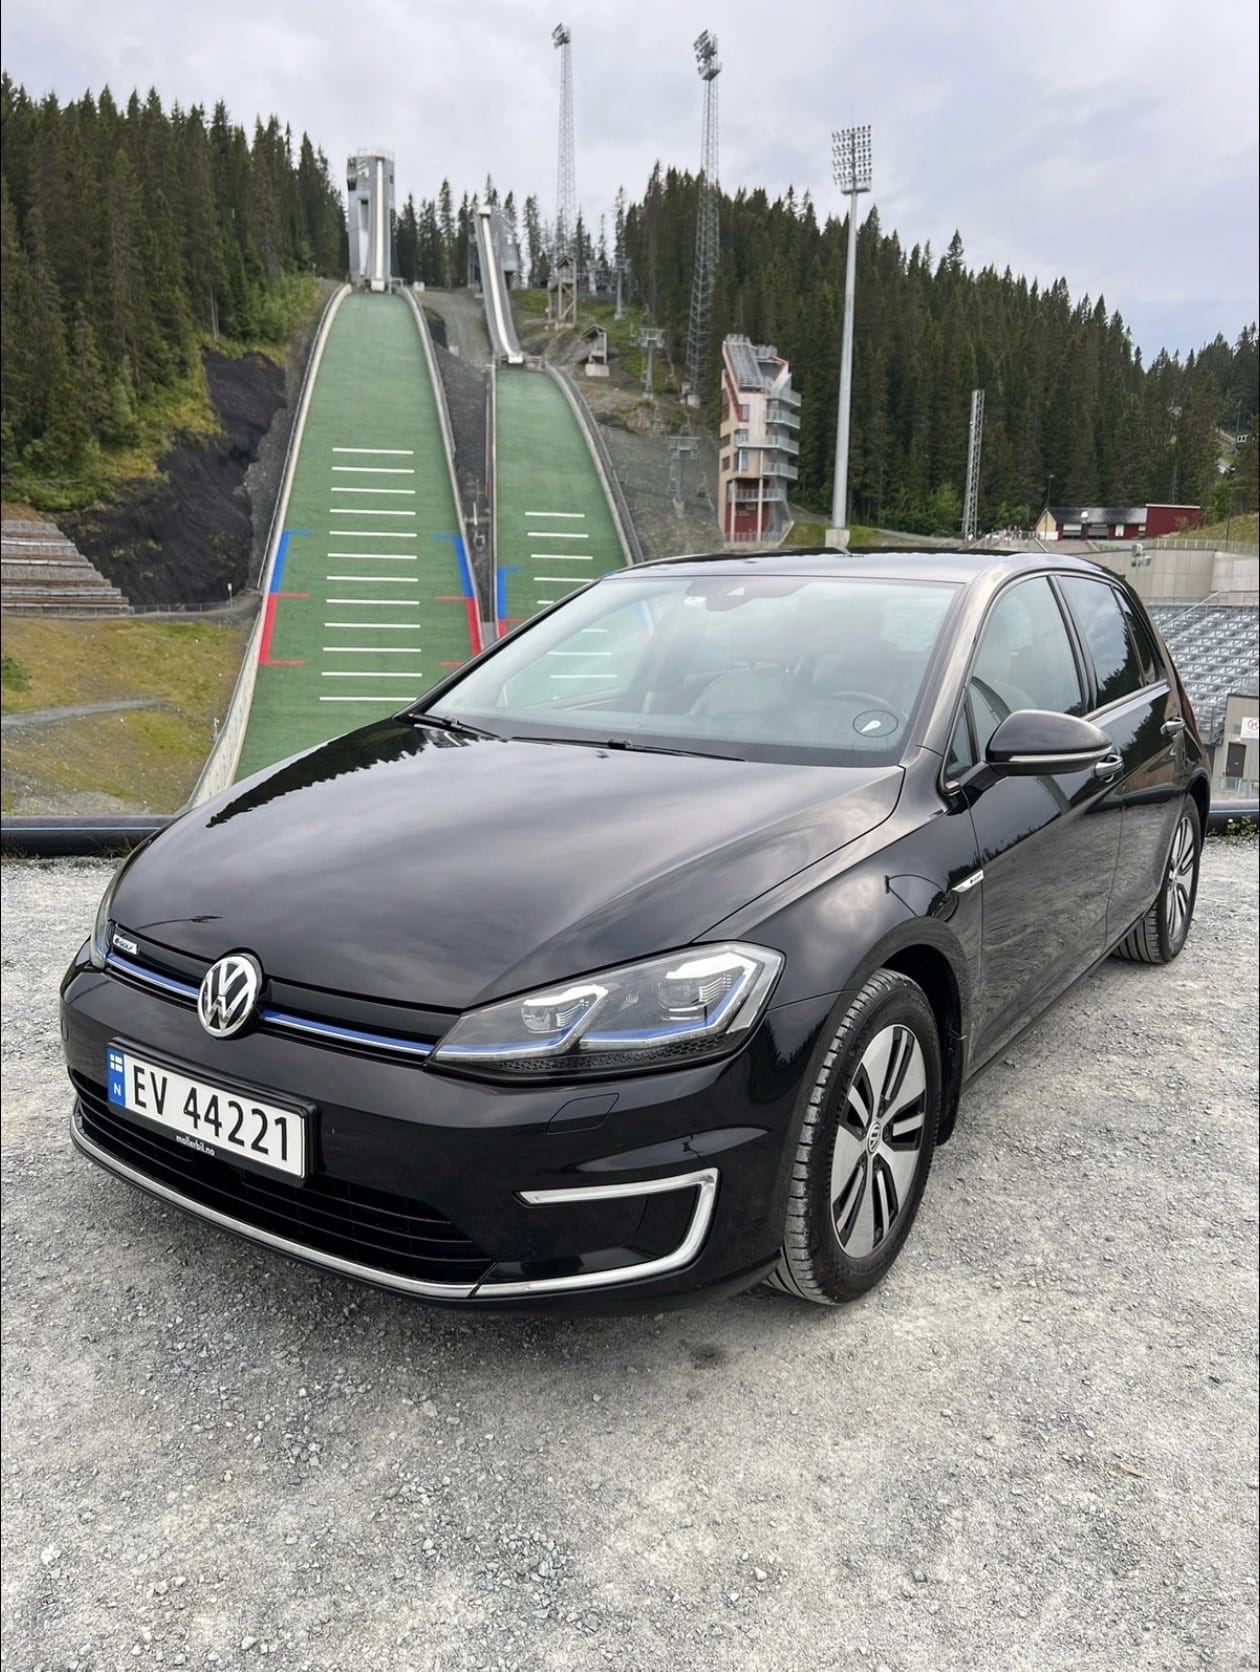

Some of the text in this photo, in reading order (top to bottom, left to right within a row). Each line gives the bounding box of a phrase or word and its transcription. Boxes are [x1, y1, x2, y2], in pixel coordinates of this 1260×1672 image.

[114, 1083, 121, 1096] N
[133, 1064, 287, 1161] EV 44221
